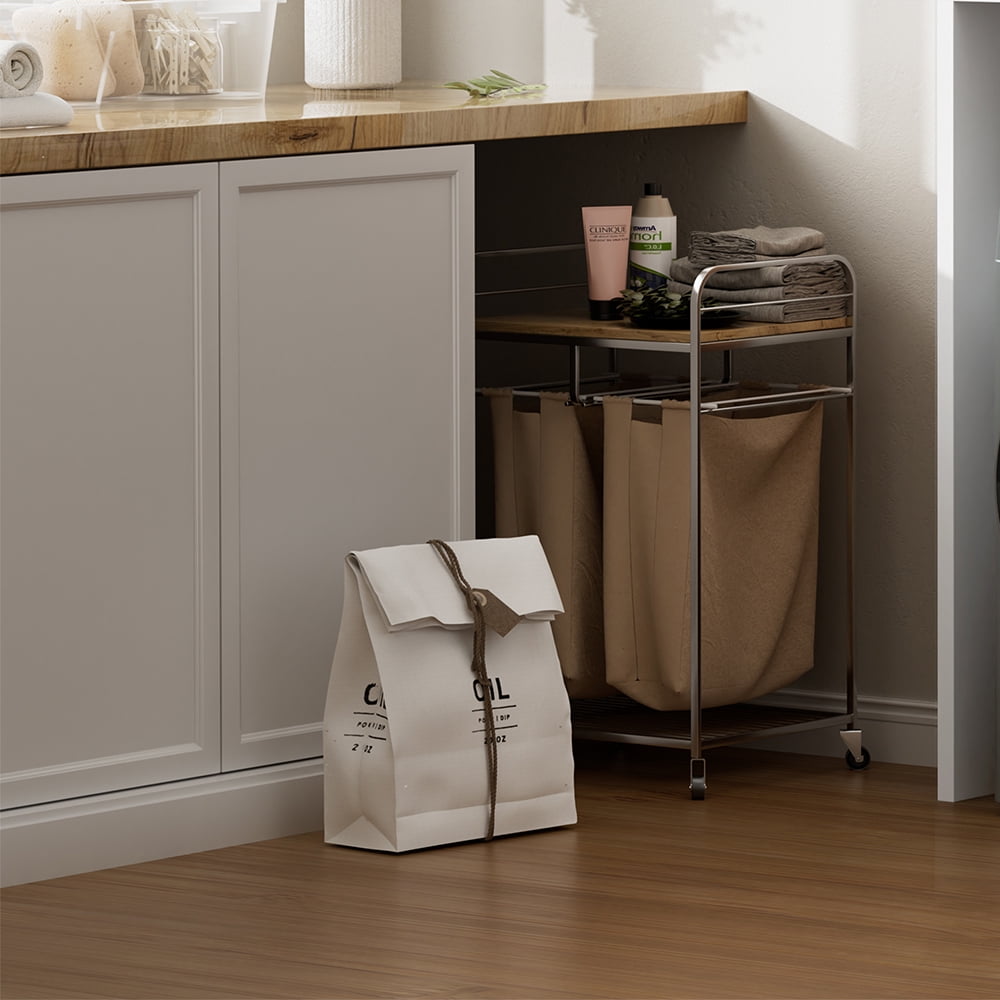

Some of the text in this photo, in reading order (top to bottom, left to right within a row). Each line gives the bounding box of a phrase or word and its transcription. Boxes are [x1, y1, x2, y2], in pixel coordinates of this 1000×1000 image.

[589, 226, 626, 234] CLINIQUE
[472, 677, 510, 702] OIL
[496, 735, 507, 744] OZ
